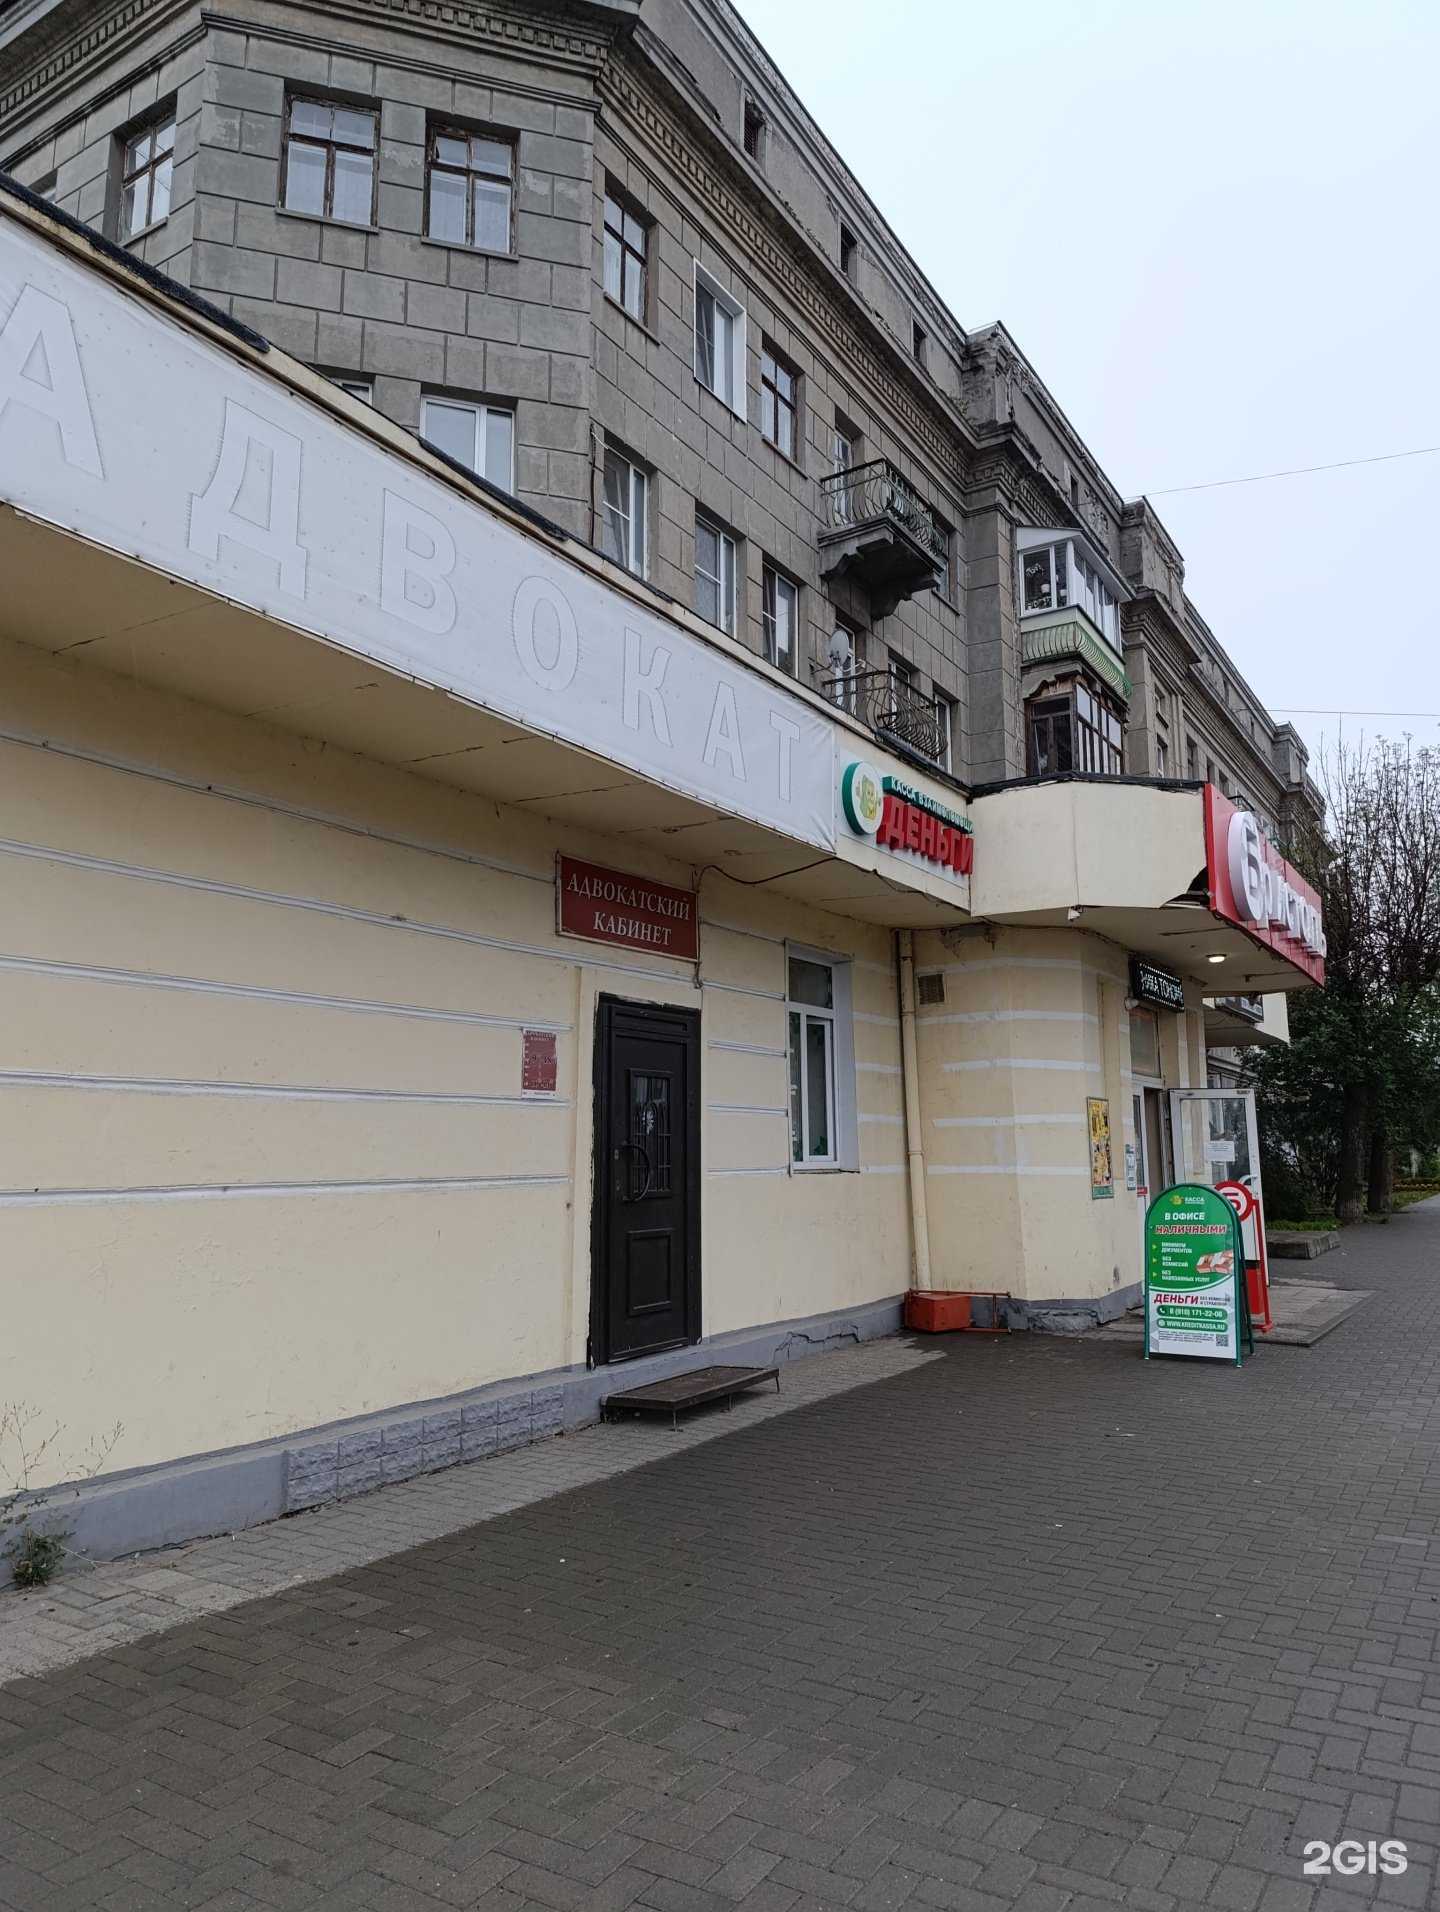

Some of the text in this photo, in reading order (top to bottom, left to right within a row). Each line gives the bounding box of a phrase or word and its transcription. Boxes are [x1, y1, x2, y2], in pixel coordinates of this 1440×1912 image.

[0, 283, 800, 803] АДВОКАТ
[891, 777, 916, 801] КАССА
[879, 795, 974, 875] ДЕНЬГИ
[566, 872, 689, 921] АДВОКАТСКИЙ
[593, 911, 672, 946] КАБИНЕТ
[1155, 1224, 1227, 1235] НАЛИЧНЫМИ
[1165, 1212, 1205, 1220] В ОФИСЕ
[1154, 1293, 1199, 1305] ДЕНЬГИ
